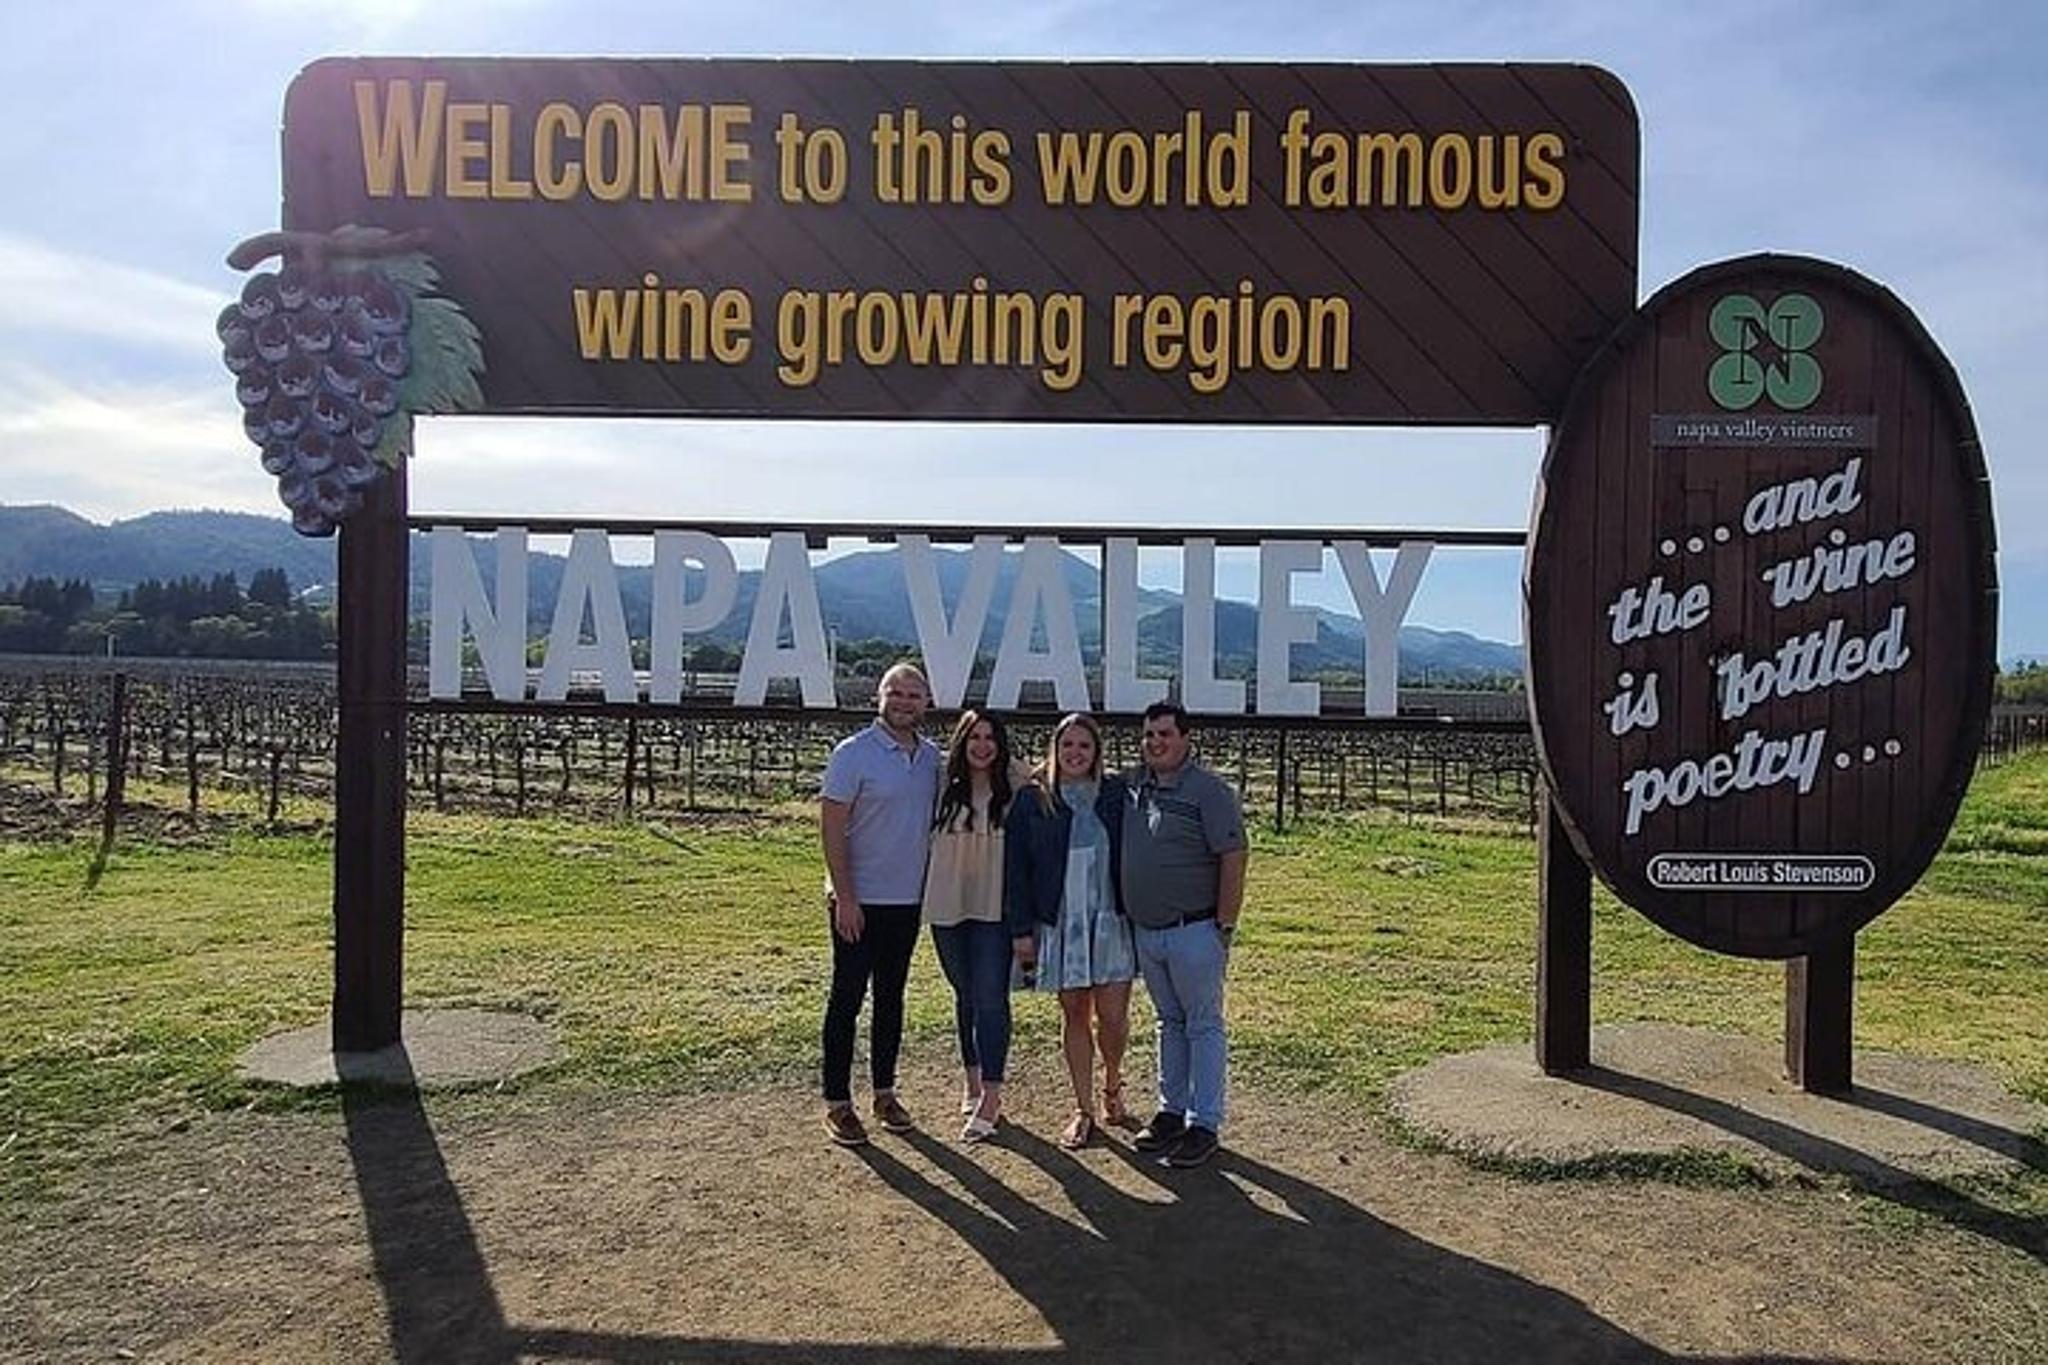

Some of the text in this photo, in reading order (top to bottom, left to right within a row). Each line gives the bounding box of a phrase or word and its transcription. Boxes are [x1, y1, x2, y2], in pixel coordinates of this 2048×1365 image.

[354, 80, 1566, 209] WELCOME to this world famous
[573, 272, 1351, 394] wine growing region
[1677, 420, 1853, 443] napa valley vintners
[429, 525, 1436, 718] NAPA VALLEY
[1608, 528, 1916, 644] the wine
[1605, 607, 1912, 736] is bottled
[1657, 861, 1865, 883] Robert Louis Stevenson
